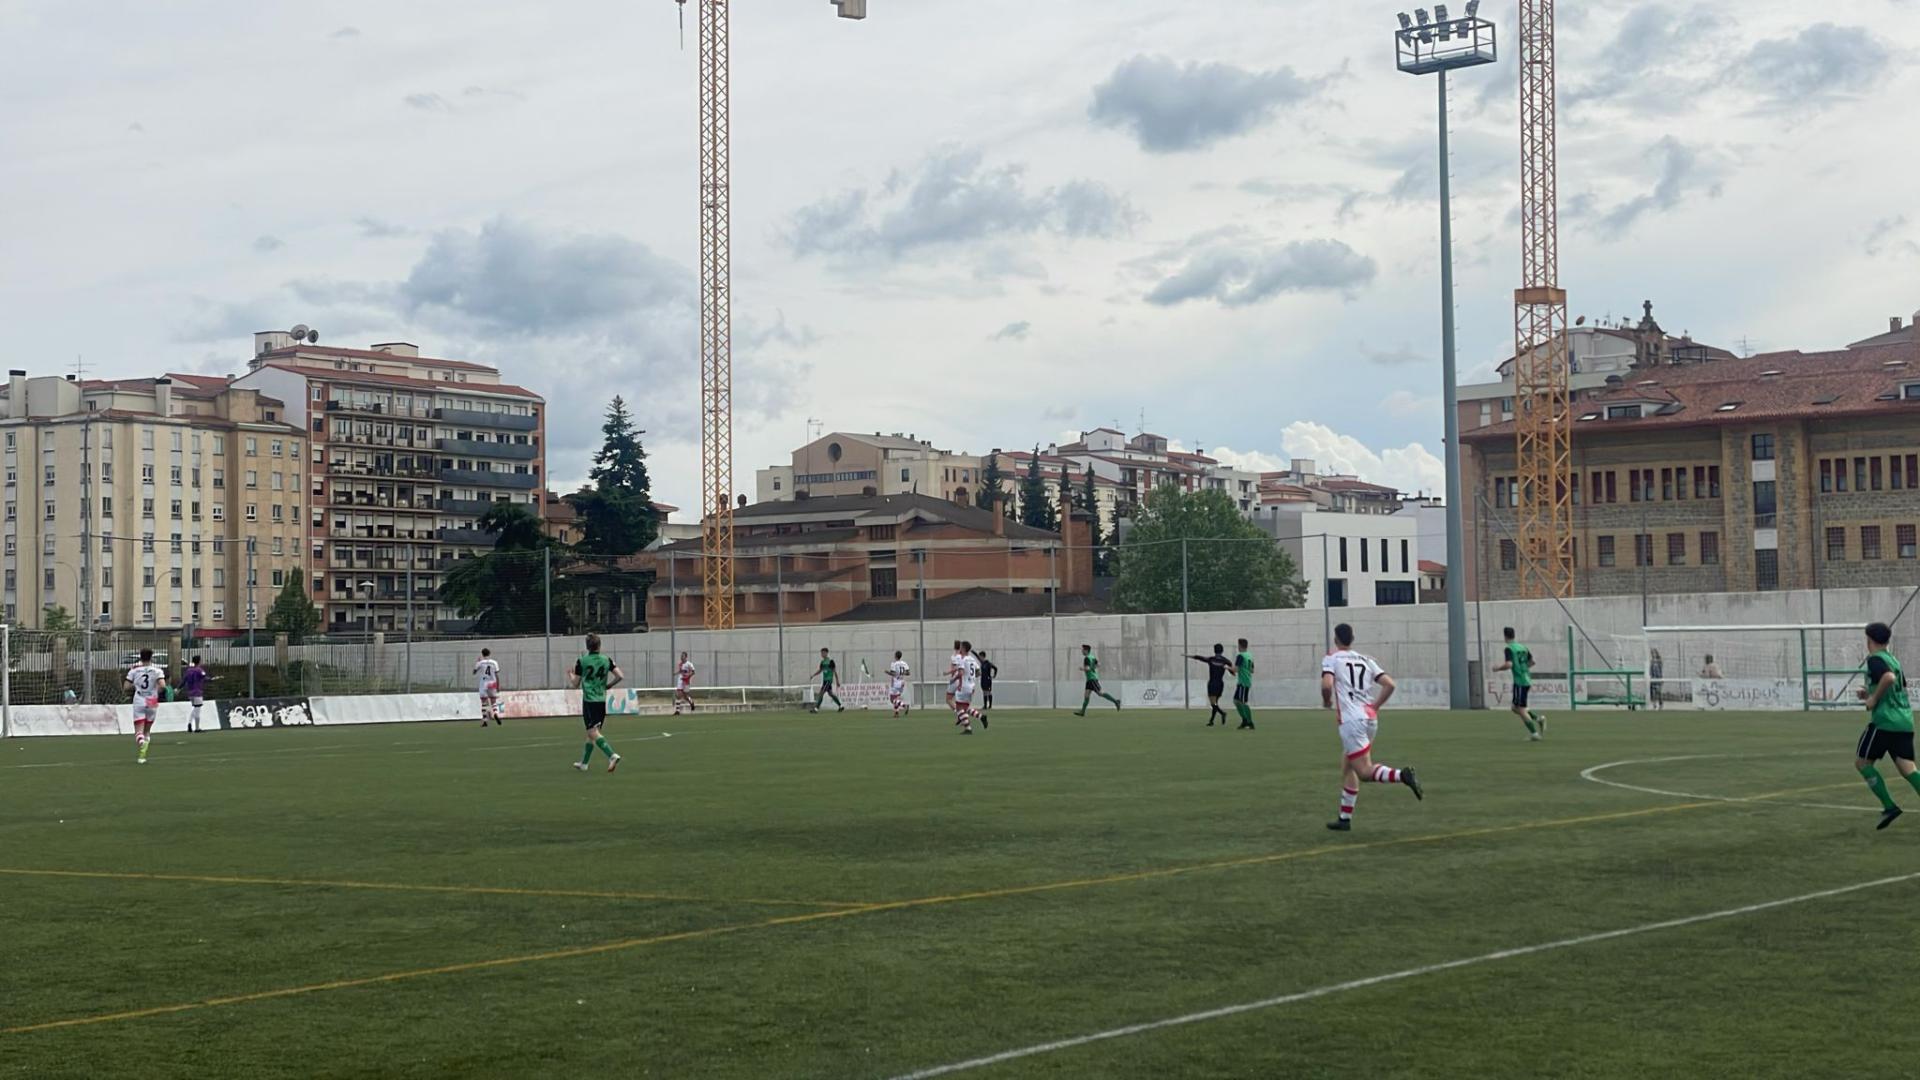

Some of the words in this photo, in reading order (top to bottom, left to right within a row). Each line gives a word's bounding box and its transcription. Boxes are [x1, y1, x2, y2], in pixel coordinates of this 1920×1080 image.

[485, 665, 491, 676] 4
[585, 664, 606, 681] 24
[969, 663, 975, 677] 5
[1346, 662, 1366, 690] 17
[141, 673, 149, 690] 3
